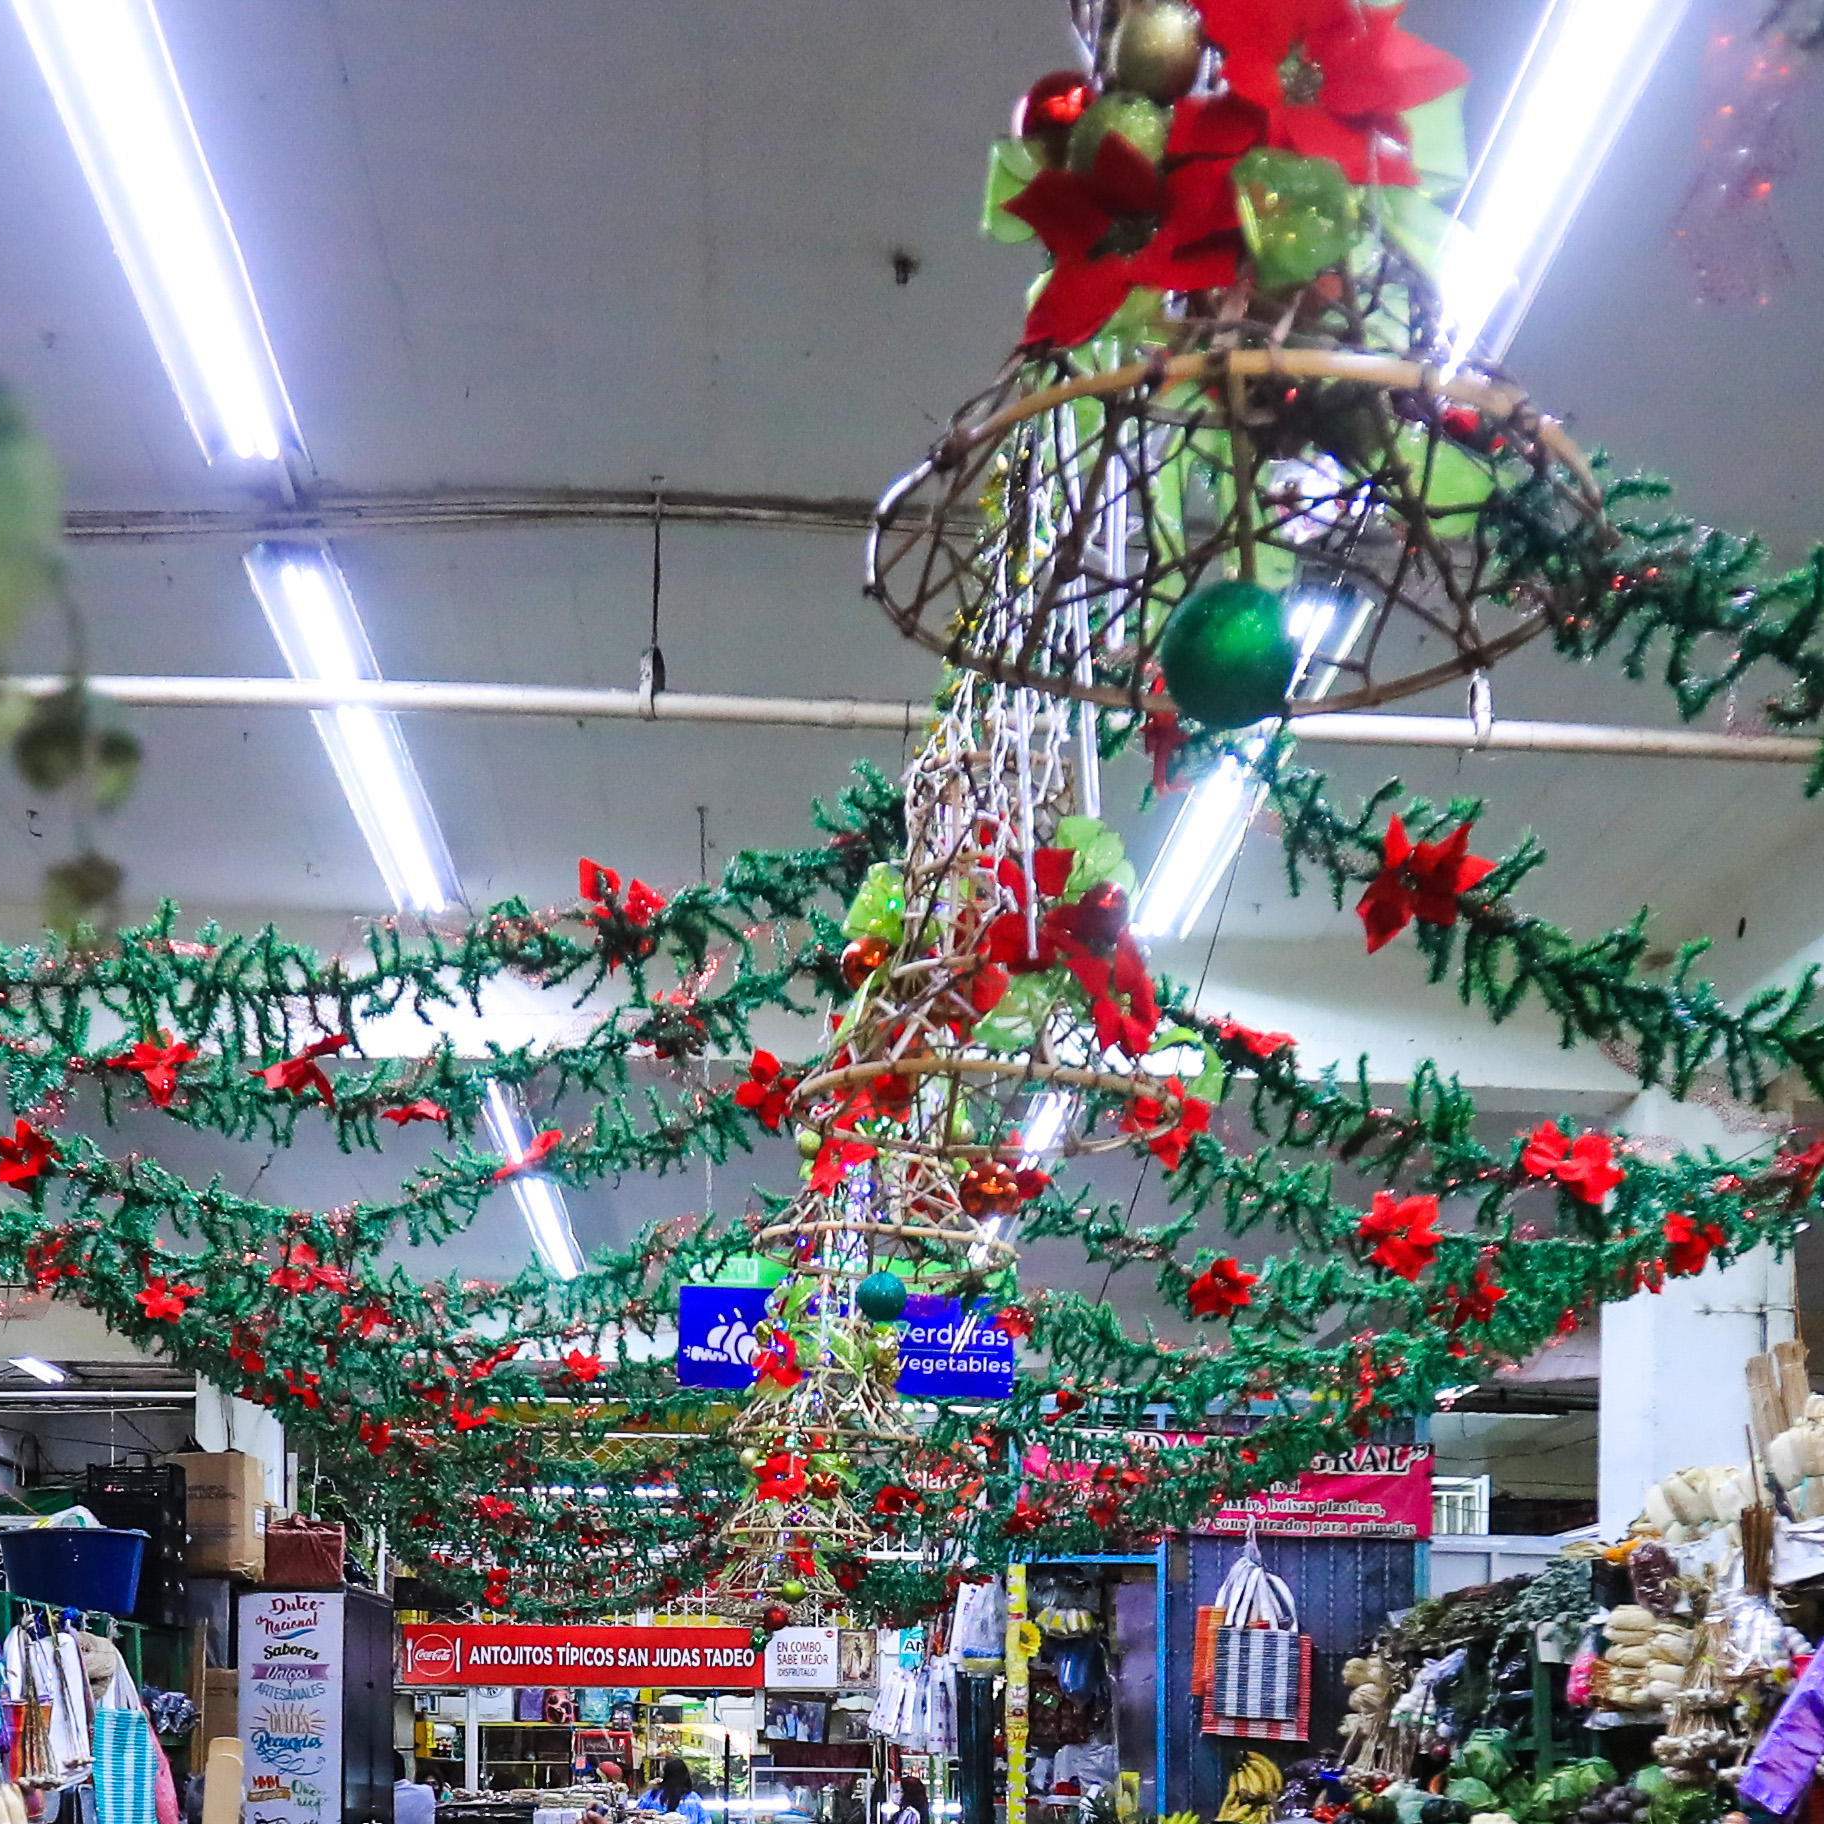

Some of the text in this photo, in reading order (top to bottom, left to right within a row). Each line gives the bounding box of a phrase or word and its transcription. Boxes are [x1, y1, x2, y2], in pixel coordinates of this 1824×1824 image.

[1269, 1498, 1316, 1513] bolsas
[1313, 1520, 1348, 1534] para
[1351, 1521, 1417, 1535] animales
[263, 1643, 319, 1660] Sabores
[468, 1642, 756, 1667] ANTOJITOS TÍPICOS SAN JUDAS TADEO
[777, 1641, 822, 1653] EN COMBO
[777, 1654, 829, 1665] SABE MEJOR
